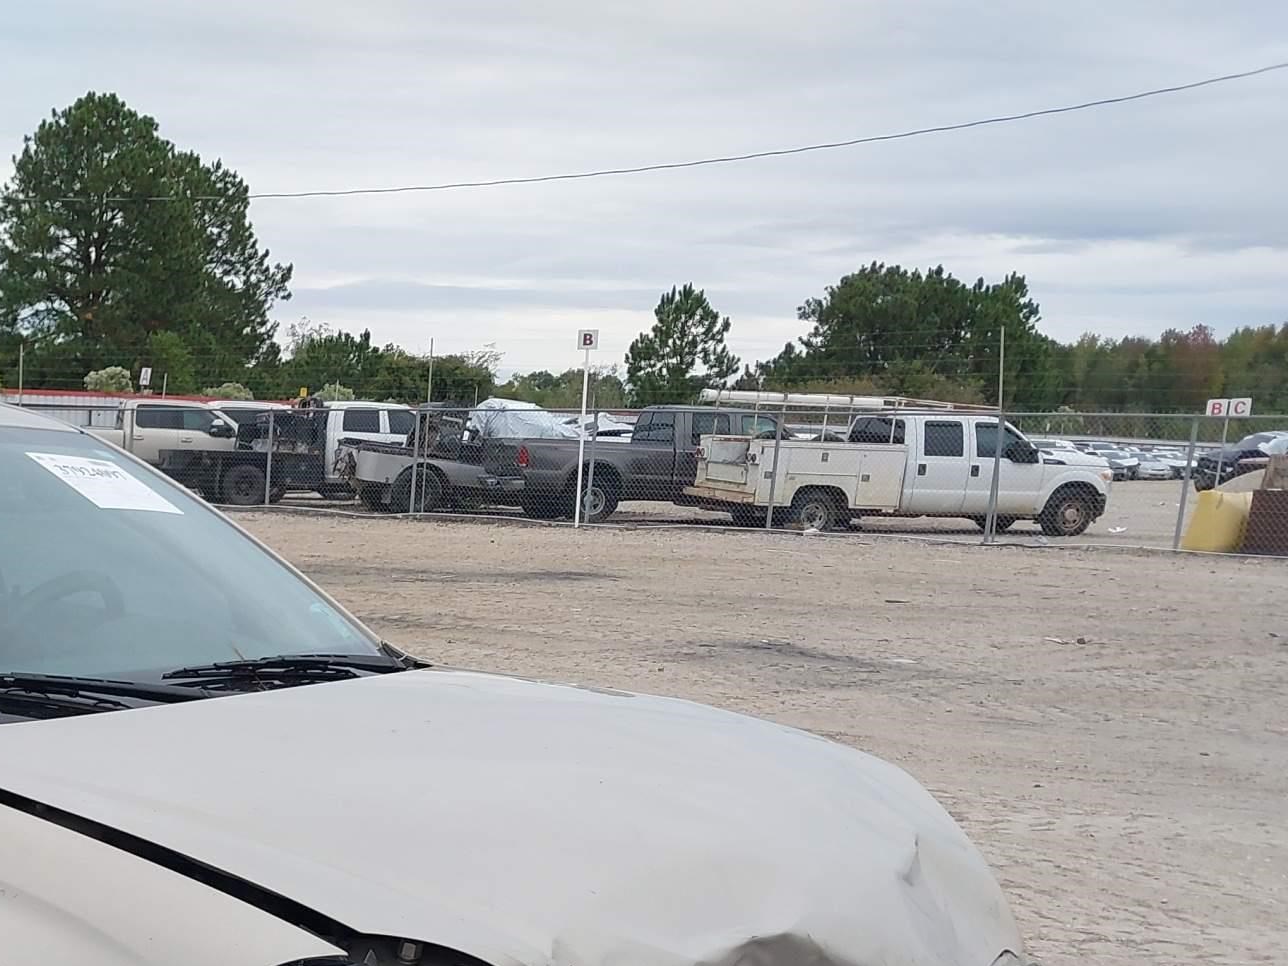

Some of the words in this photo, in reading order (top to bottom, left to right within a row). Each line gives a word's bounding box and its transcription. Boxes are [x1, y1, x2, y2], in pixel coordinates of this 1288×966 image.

[582, 333, 594, 346] B
[141, 368, 150, 384] A
[1211, 402, 1223, 416] B
[1234, 401, 1247, 415] C
